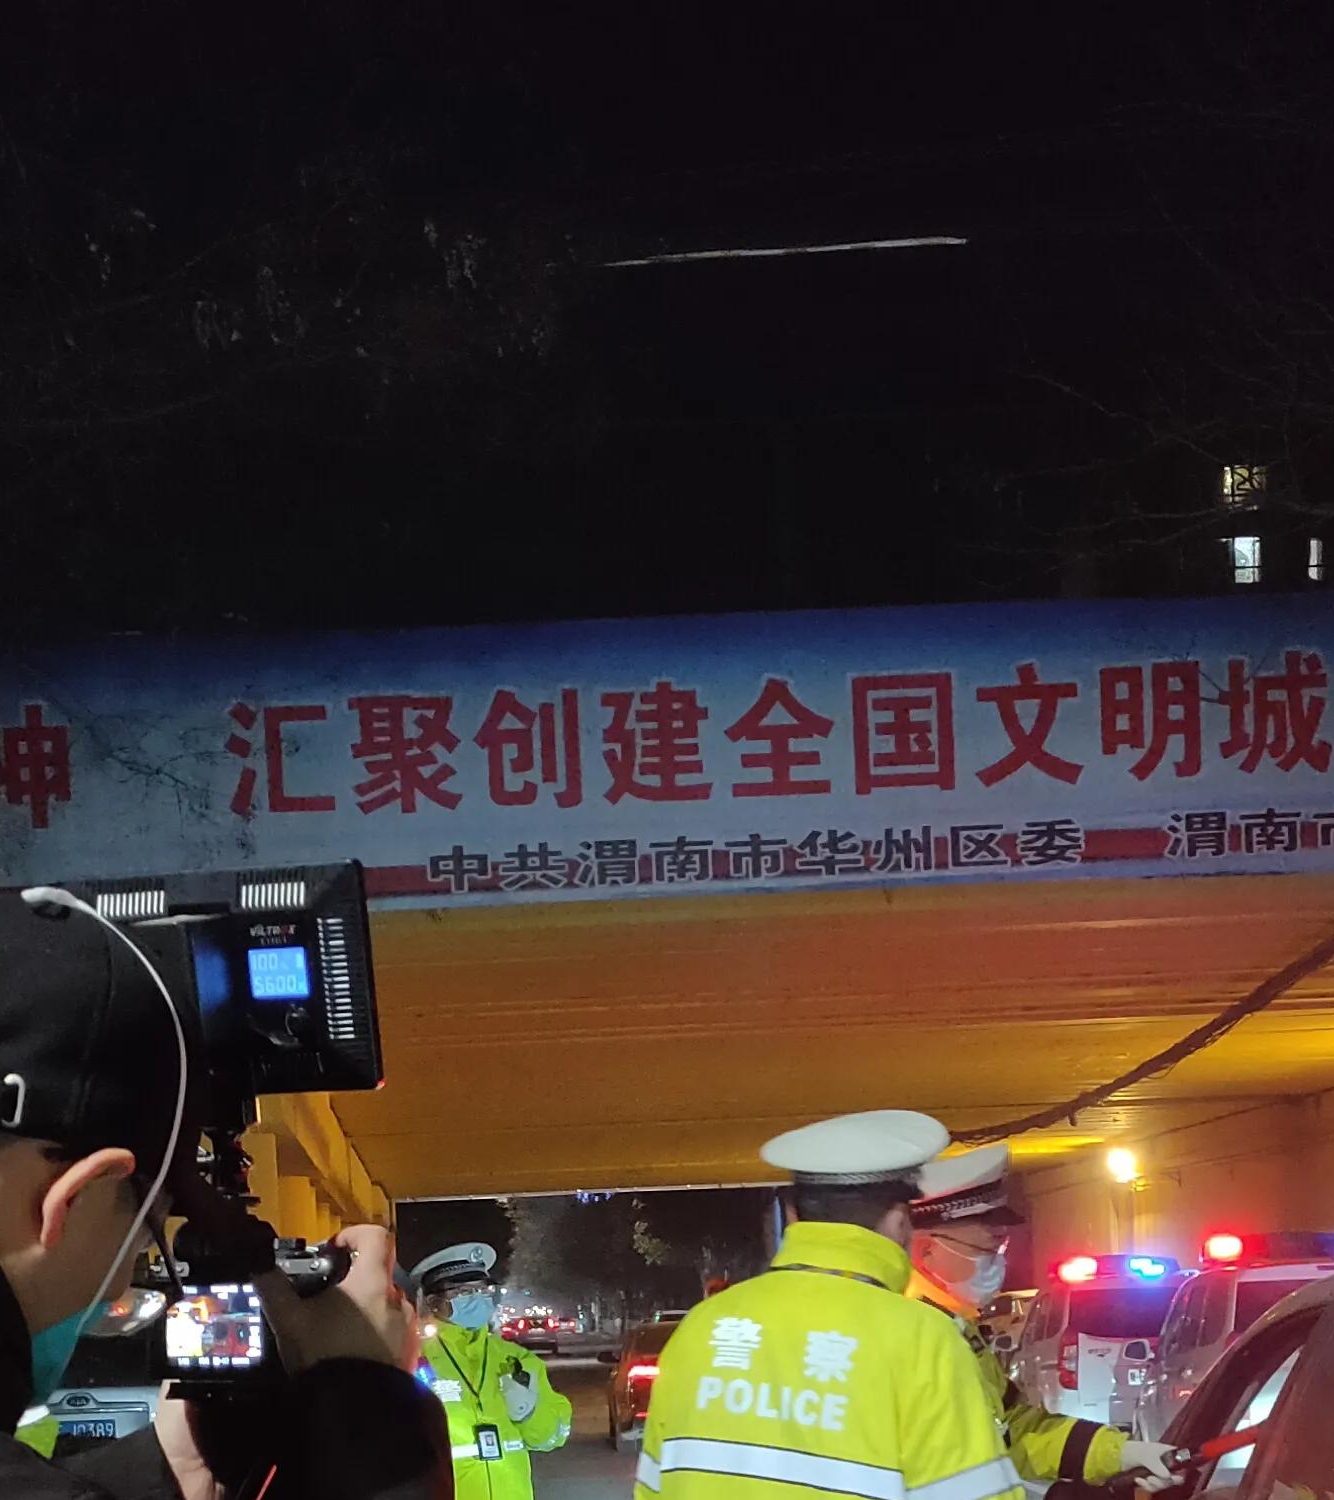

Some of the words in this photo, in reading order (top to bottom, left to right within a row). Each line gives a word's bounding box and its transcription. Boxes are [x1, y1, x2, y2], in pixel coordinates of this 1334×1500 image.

[429, 818, 1084, 895] 中共渭南市华州区委
[708, 1316, 860, 1383] 警察
[695, 1375, 849, 1432] POLICE
